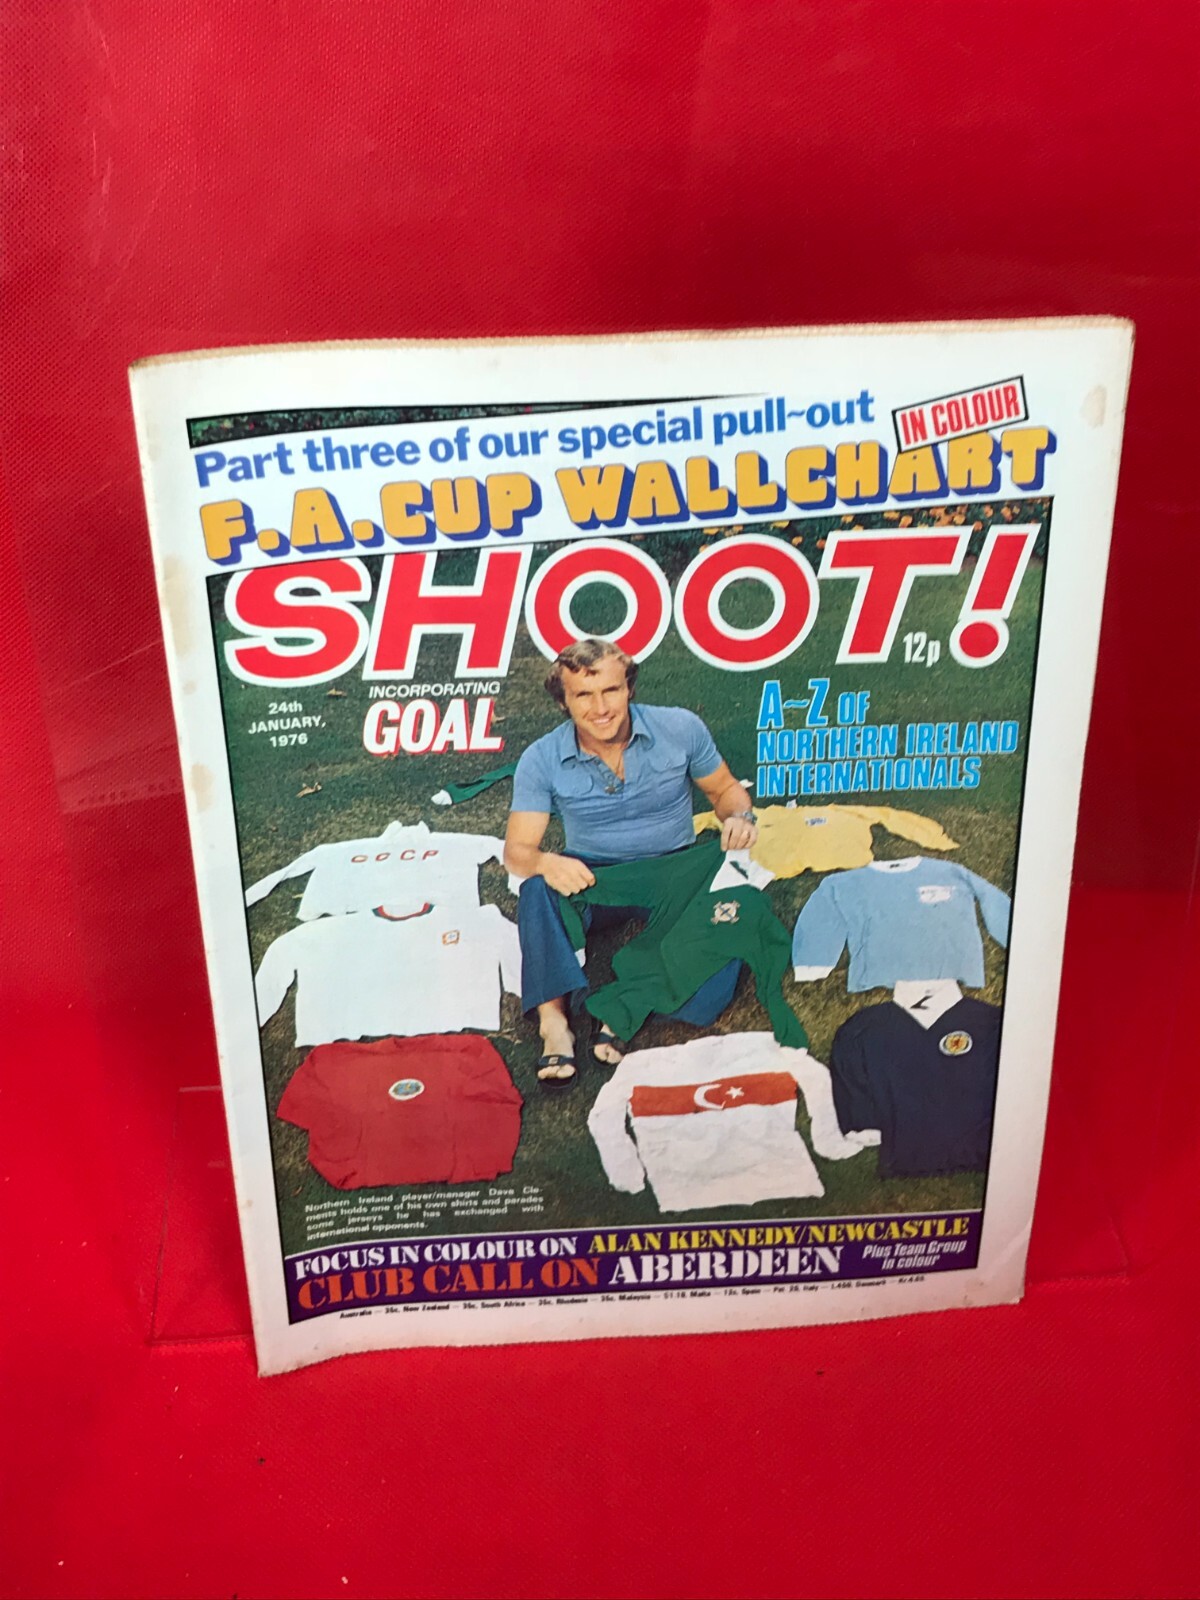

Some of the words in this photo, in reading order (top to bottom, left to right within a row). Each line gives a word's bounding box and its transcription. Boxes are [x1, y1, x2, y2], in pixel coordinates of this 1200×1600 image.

[900, 408, 926, 447] IN
[932, 383, 1022, 434] COLOUR
[195, 442, 295, 488] Part
[303, 436, 420, 472] three
[429, 426, 470, 464] of
[478, 429, 549, 459] our
[558, 407, 702, 458] special
[555, 426, 1058, 531] WALLCHART
[223, 523, 1042, 688] SHOOT!
[902, 632, 941, 668] 12p
[368, 680, 502, 700] INCORPORATING
[267, 701, 304, 716] 24th
[838, 690, 872, 726] OF
[248, 716, 327, 734] JANUARY,
[269, 732, 310, 749] 1976
[363, 698, 504, 755] GOAL
[755, 728, 900, 764] NORTHERN
[905, 720, 1019, 756] IRELAND
[755, 756, 983, 799] INTERNATIONALS
[305, 1199, 351, 1213] Northern
[358, 1194, 394, 1204] Ireland
[401, 1190, 481, 1203] player/manager
[488, 1188, 515, 1196] Dave
[305, 1210, 338, 1222] ments
[340, 1205, 369, 1216] holds
[371, 1204, 391, 1213] one
[393, 1202, 405, 1212] of
[407, 1201, 423, 1211] his
[424, 1200, 448, 1209] own
[450, 1199, 479, 1208] shirts
[481, 1197, 501, 1206] and
[504, 1195, 544, 1206] parades
[306, 1220, 335, 1232] some
[347, 1214, 383, 1225] jerseys
[396, 1211, 410, 1220] he
[422, 1210, 441, 1218] has
[454, 1206, 508, 1217] exchanged
[521, 1204, 544, 1213] with
[306, 1224, 371, 1242] international
[295, 1248, 386, 1280] FOCUS
[390, 1245, 421, 1264] IN
[424, 1239, 536, 1261] COLOUR
[540, 1237, 578, 1256] ON
[588, 1227, 664, 1254] ALAN
[668, 1216, 969, 1249] KENNEDY/NEWCASTLE
[861, 1244, 893, 1260] Plus
[893, 1242, 927, 1257] Team
[927, 1239, 968, 1255] Group
[896, 1254, 940, 1269] colour
[298, 1268, 415, 1310] CLUB
[423, 1261, 534, 1293] CALL
[540, 1258, 599, 1289] ON
[608, 1246, 844, 1286] ABERDEEN
[402, 1305, 420, 1313] New
[503, 1300, 526, 1308] Africa
